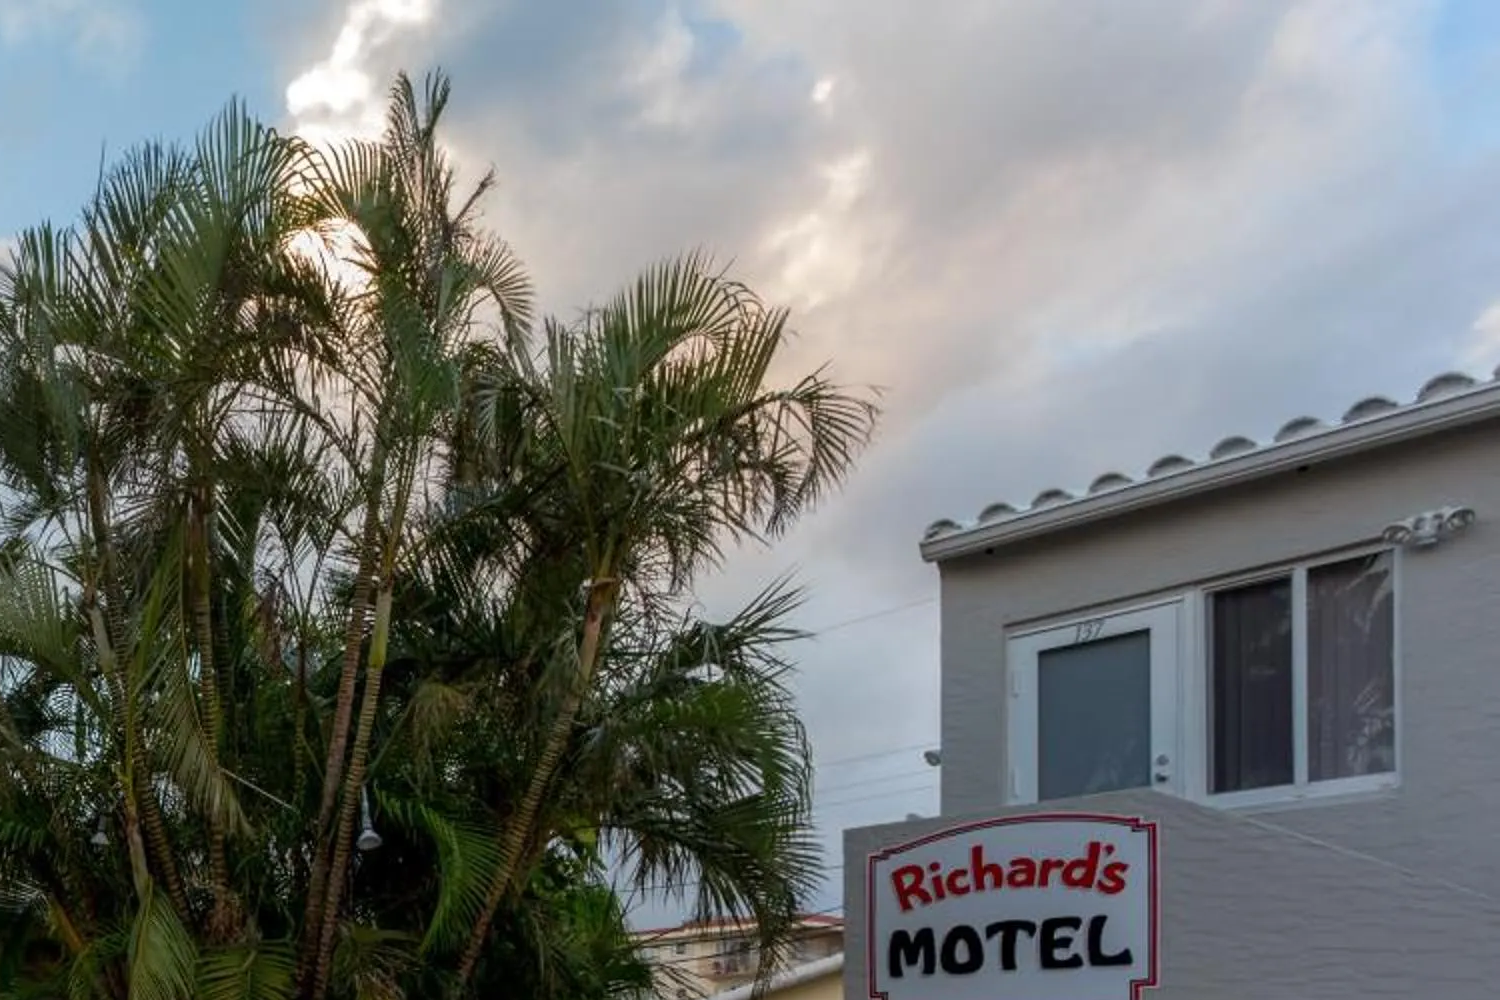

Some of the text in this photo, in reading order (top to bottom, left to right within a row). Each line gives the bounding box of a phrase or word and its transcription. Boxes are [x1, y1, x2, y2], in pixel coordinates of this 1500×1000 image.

[1075, 618, 1105, 642] 137
[891, 841, 1130, 913] Richard's
[888, 914, 1133, 978] MOTEL
